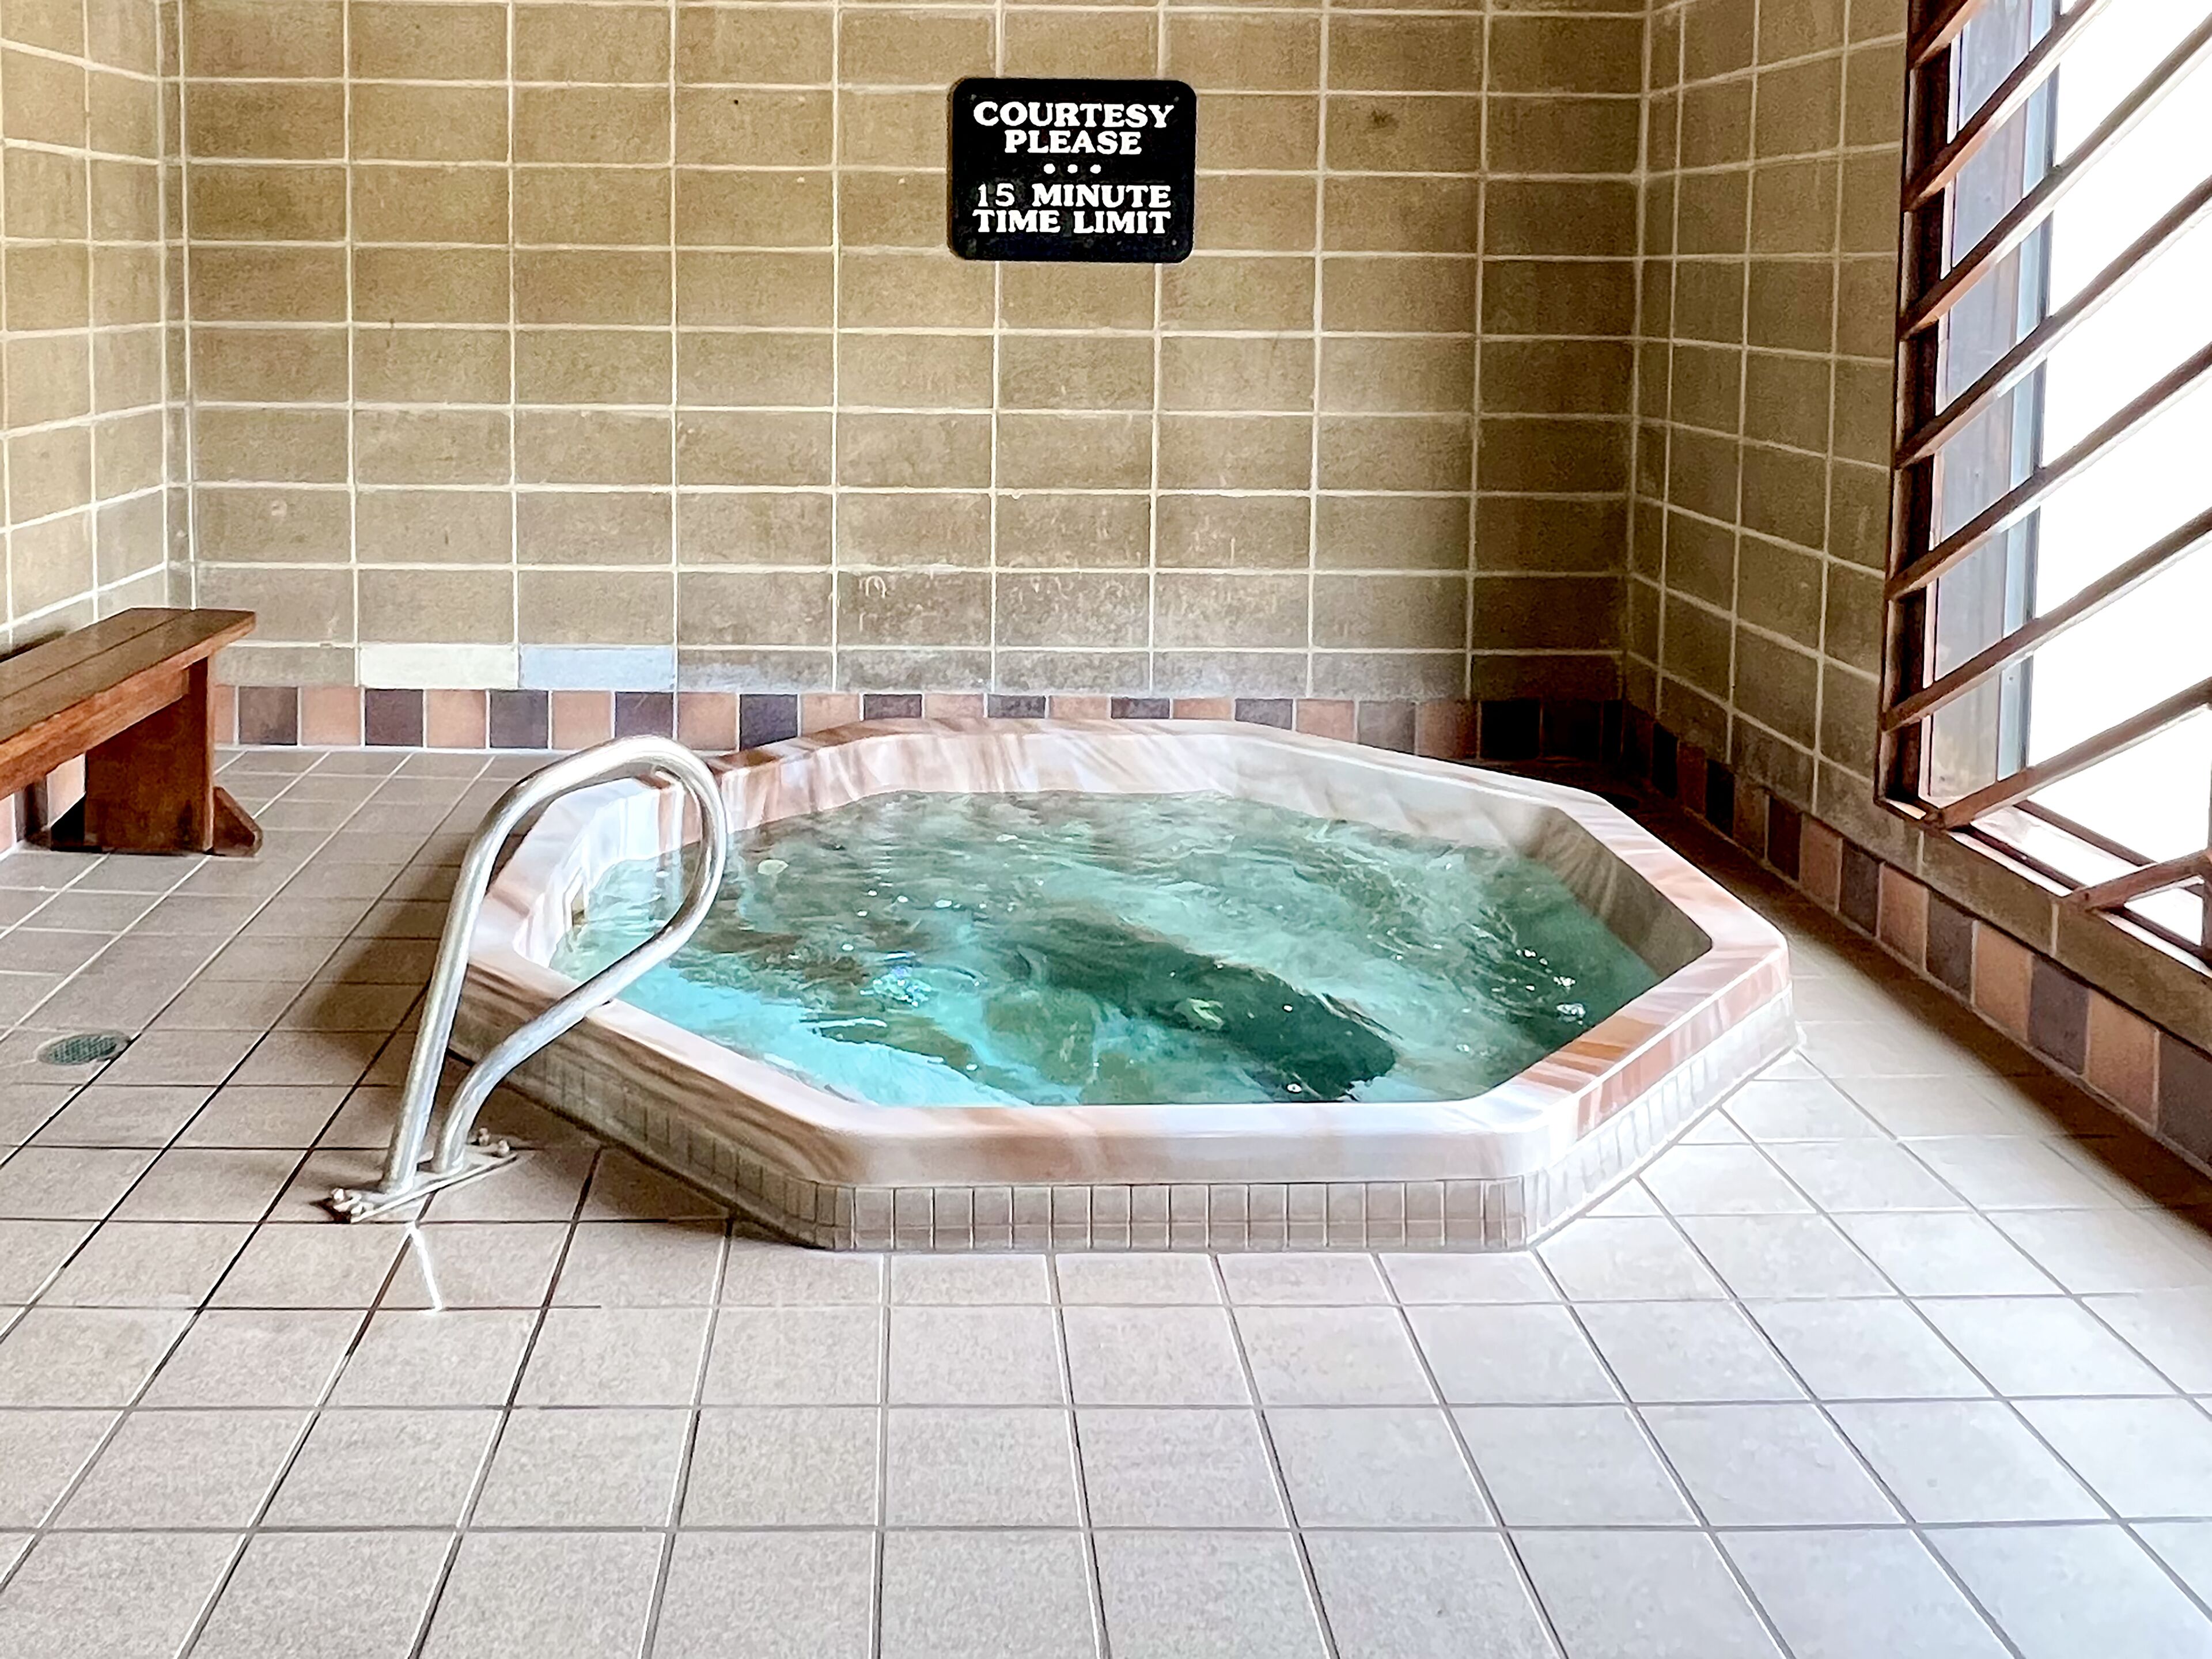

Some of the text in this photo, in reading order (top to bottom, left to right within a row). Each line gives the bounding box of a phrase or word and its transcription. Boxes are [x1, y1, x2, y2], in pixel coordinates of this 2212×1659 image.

[973, 101, 1175, 128] COURTESY
[1004, 130, 1142, 155] PLEASE
[978, 183, 1171, 208] 15 MINUTE
[972, 209, 1171, 234] TIME LIMIT
